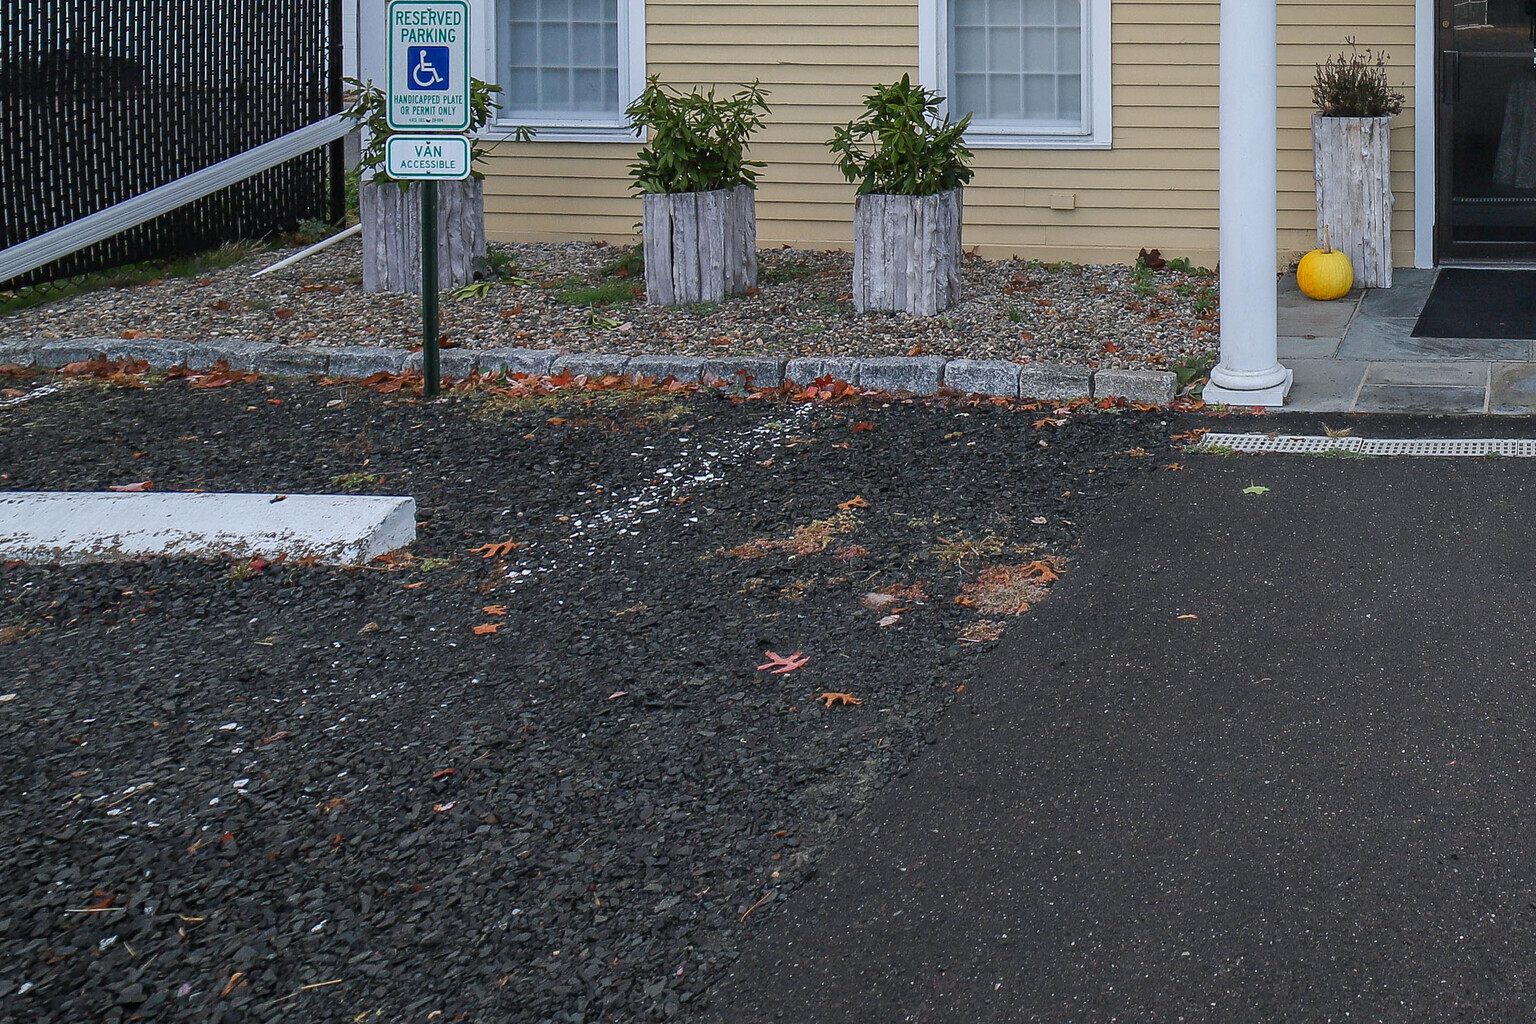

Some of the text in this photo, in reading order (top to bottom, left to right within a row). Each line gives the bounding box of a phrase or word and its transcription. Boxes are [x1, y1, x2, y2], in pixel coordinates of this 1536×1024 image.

[396, 11, 461, 26] RESERVED
[401, 29, 456, 43] PARKING
[394, 95, 463, 104] HANDICAPPED PLATE
[400, 106, 456, 115] OR PERMIT ONLY
[415, 145, 442, 157] VAN
[400, 160, 456, 169] ACCESSIBLE
